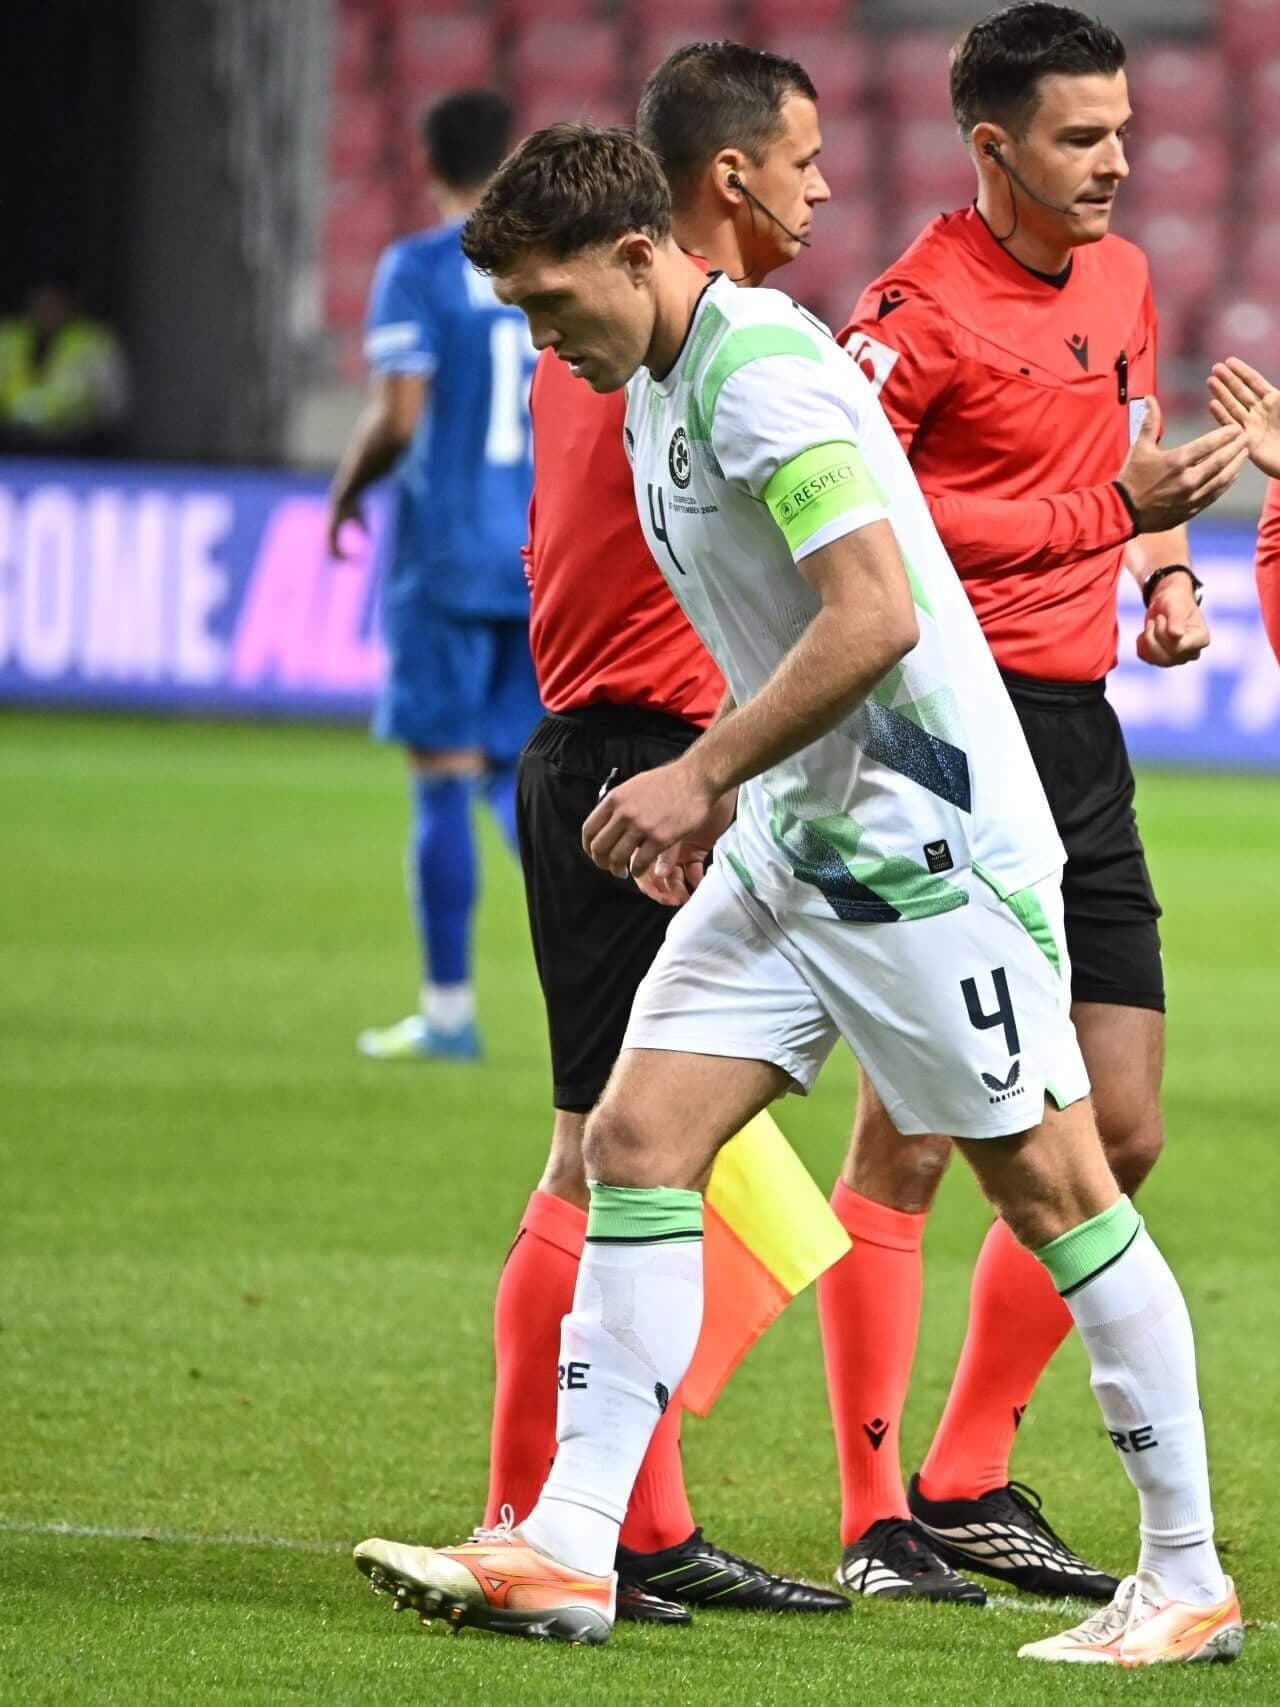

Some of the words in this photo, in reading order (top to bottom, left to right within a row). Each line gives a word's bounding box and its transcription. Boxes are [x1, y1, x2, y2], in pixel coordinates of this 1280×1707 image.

[648, 483, 687, 575] 4
[793, 465, 856, 506] RESPECT
[0, 484, 234, 686] OME
[960, 966, 1021, 1056] 4
